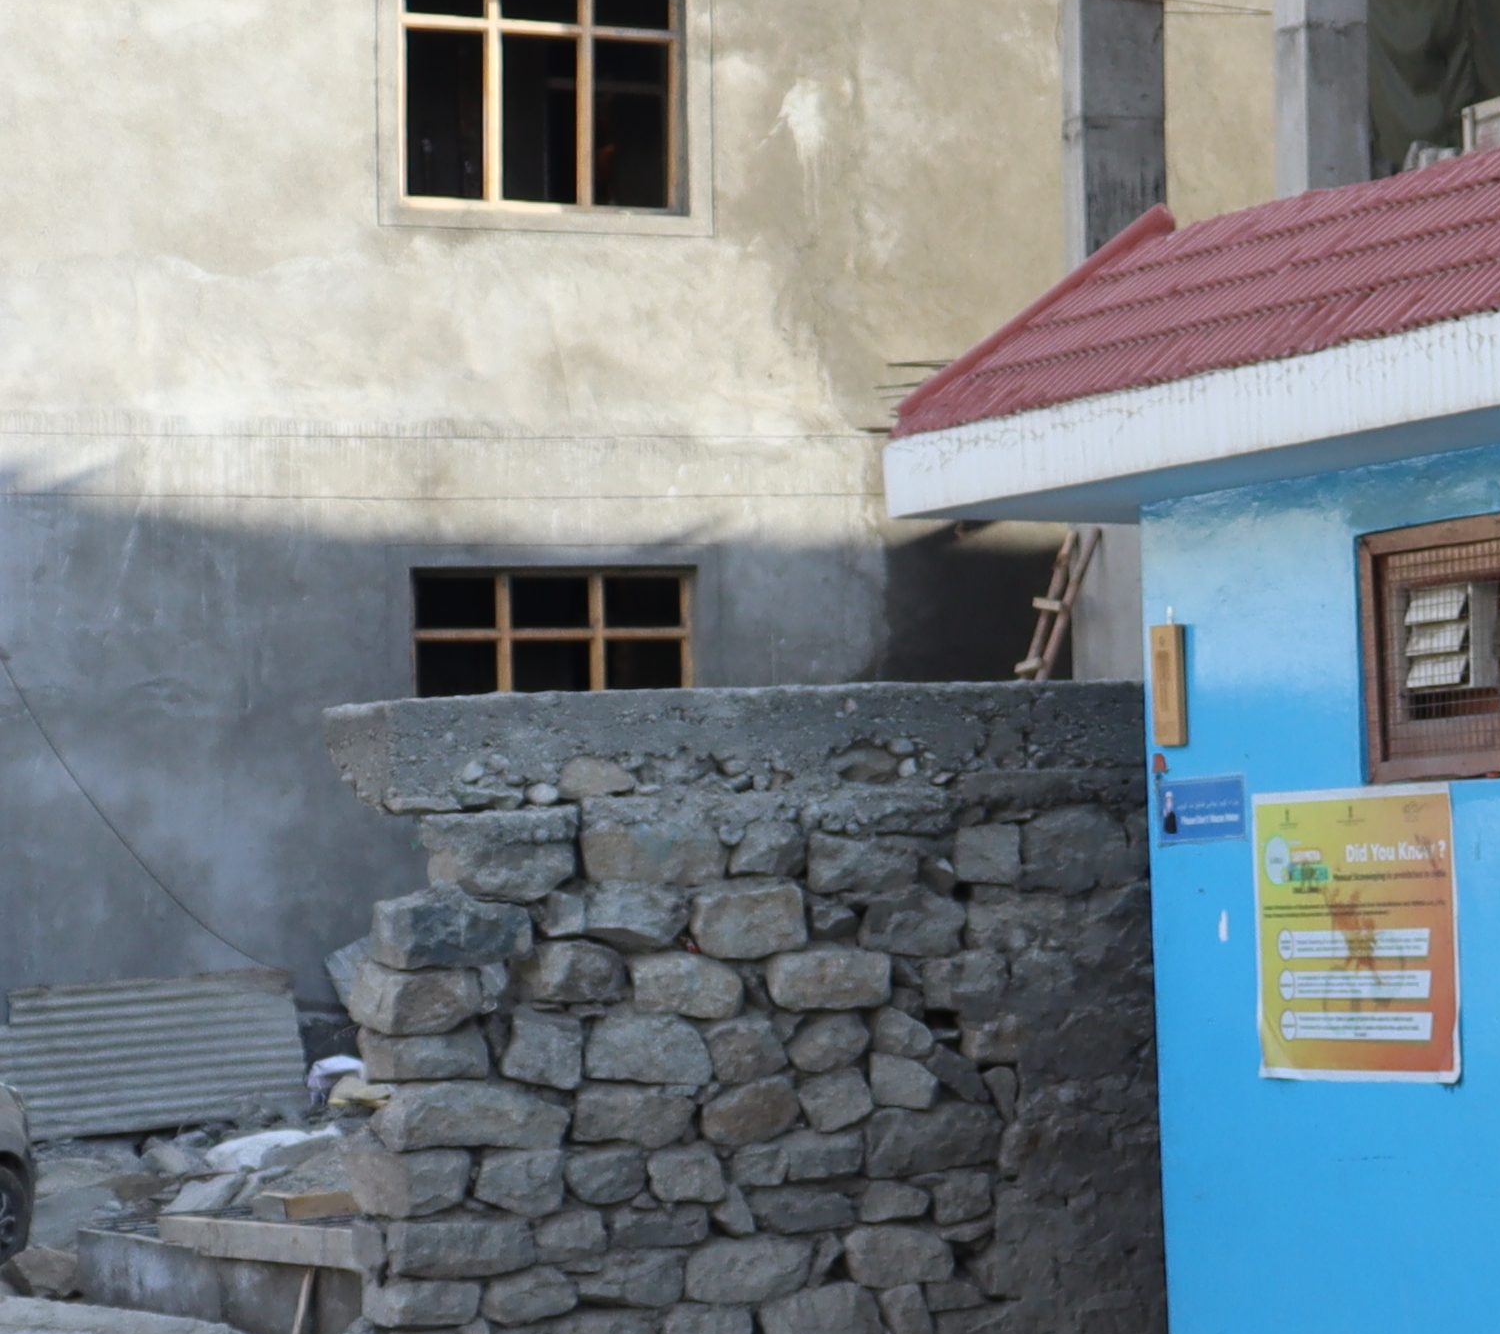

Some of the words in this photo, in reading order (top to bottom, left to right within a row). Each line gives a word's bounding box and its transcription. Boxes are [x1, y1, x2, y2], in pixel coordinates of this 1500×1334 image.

[1345, 844, 1368, 862] Did
[1370, 843, 1395, 861] You
[1438, 840, 1447, 858] ?
